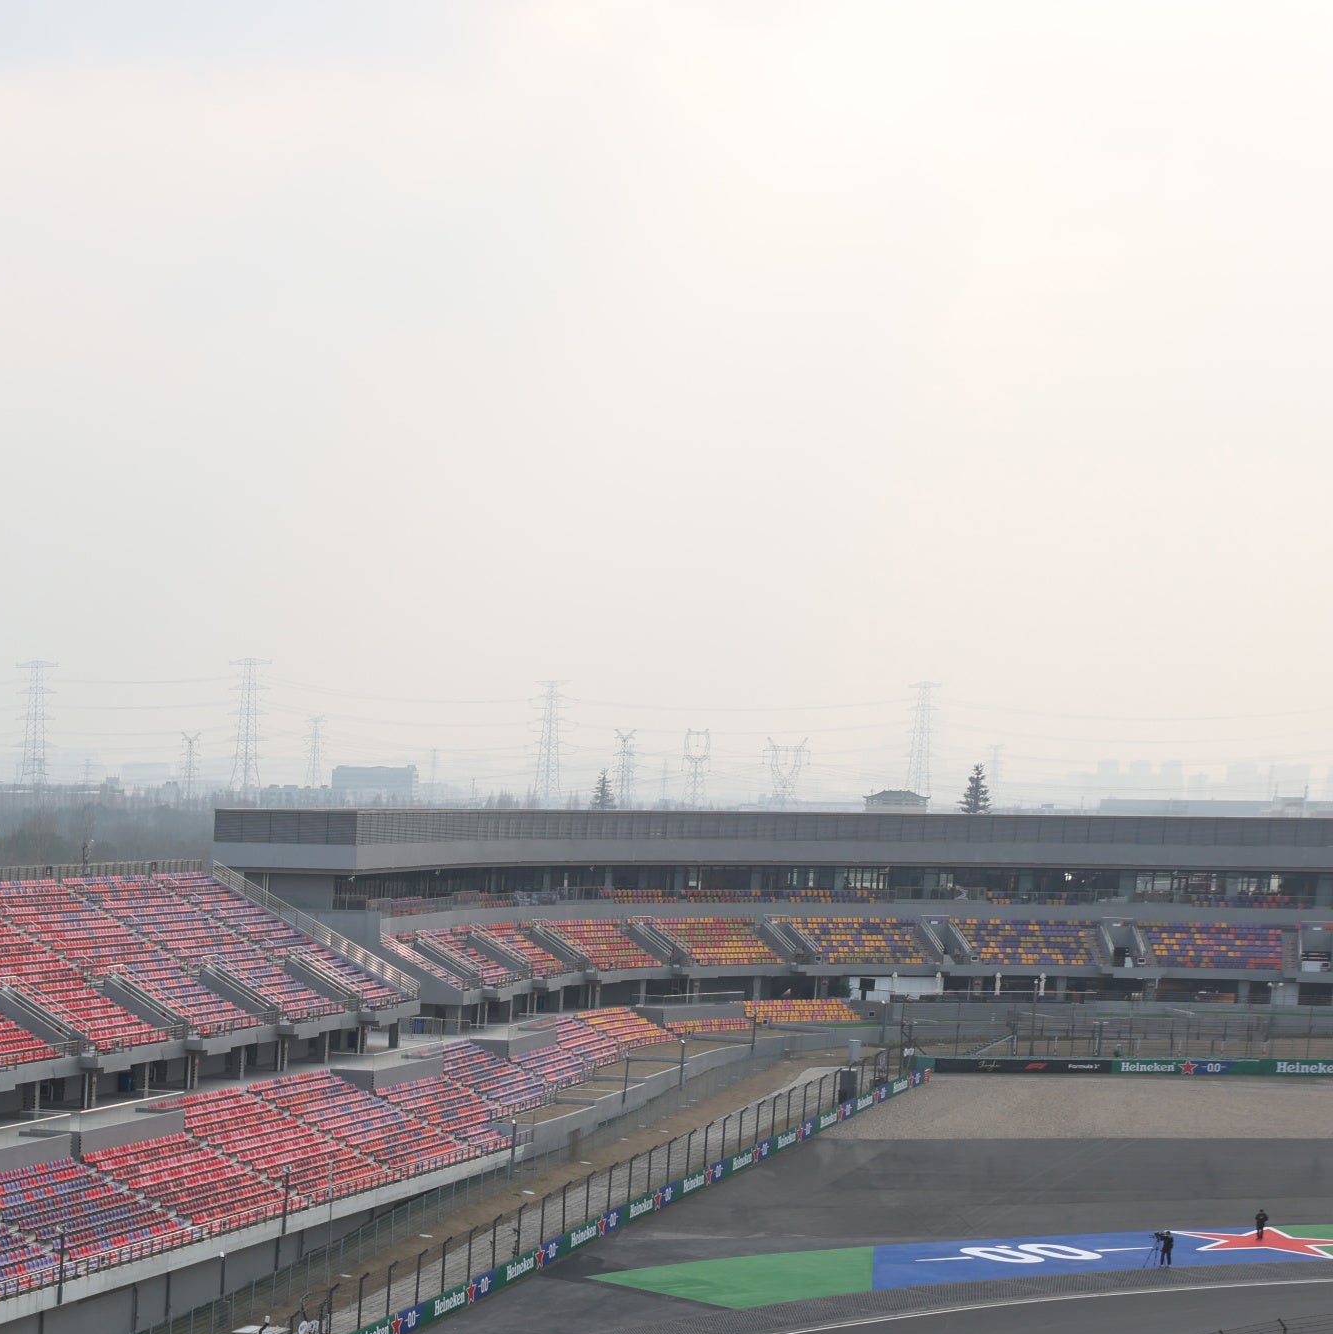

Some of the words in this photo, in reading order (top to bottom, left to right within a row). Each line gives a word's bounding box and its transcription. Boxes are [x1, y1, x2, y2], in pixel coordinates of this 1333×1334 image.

[1121, 1062, 1175, 1072] Heineken
[1276, 1062, 1333, 1073] Heineke
[506, 1256, 534, 1281] Heineken
[434, 1290, 466, 1317] Heineken
